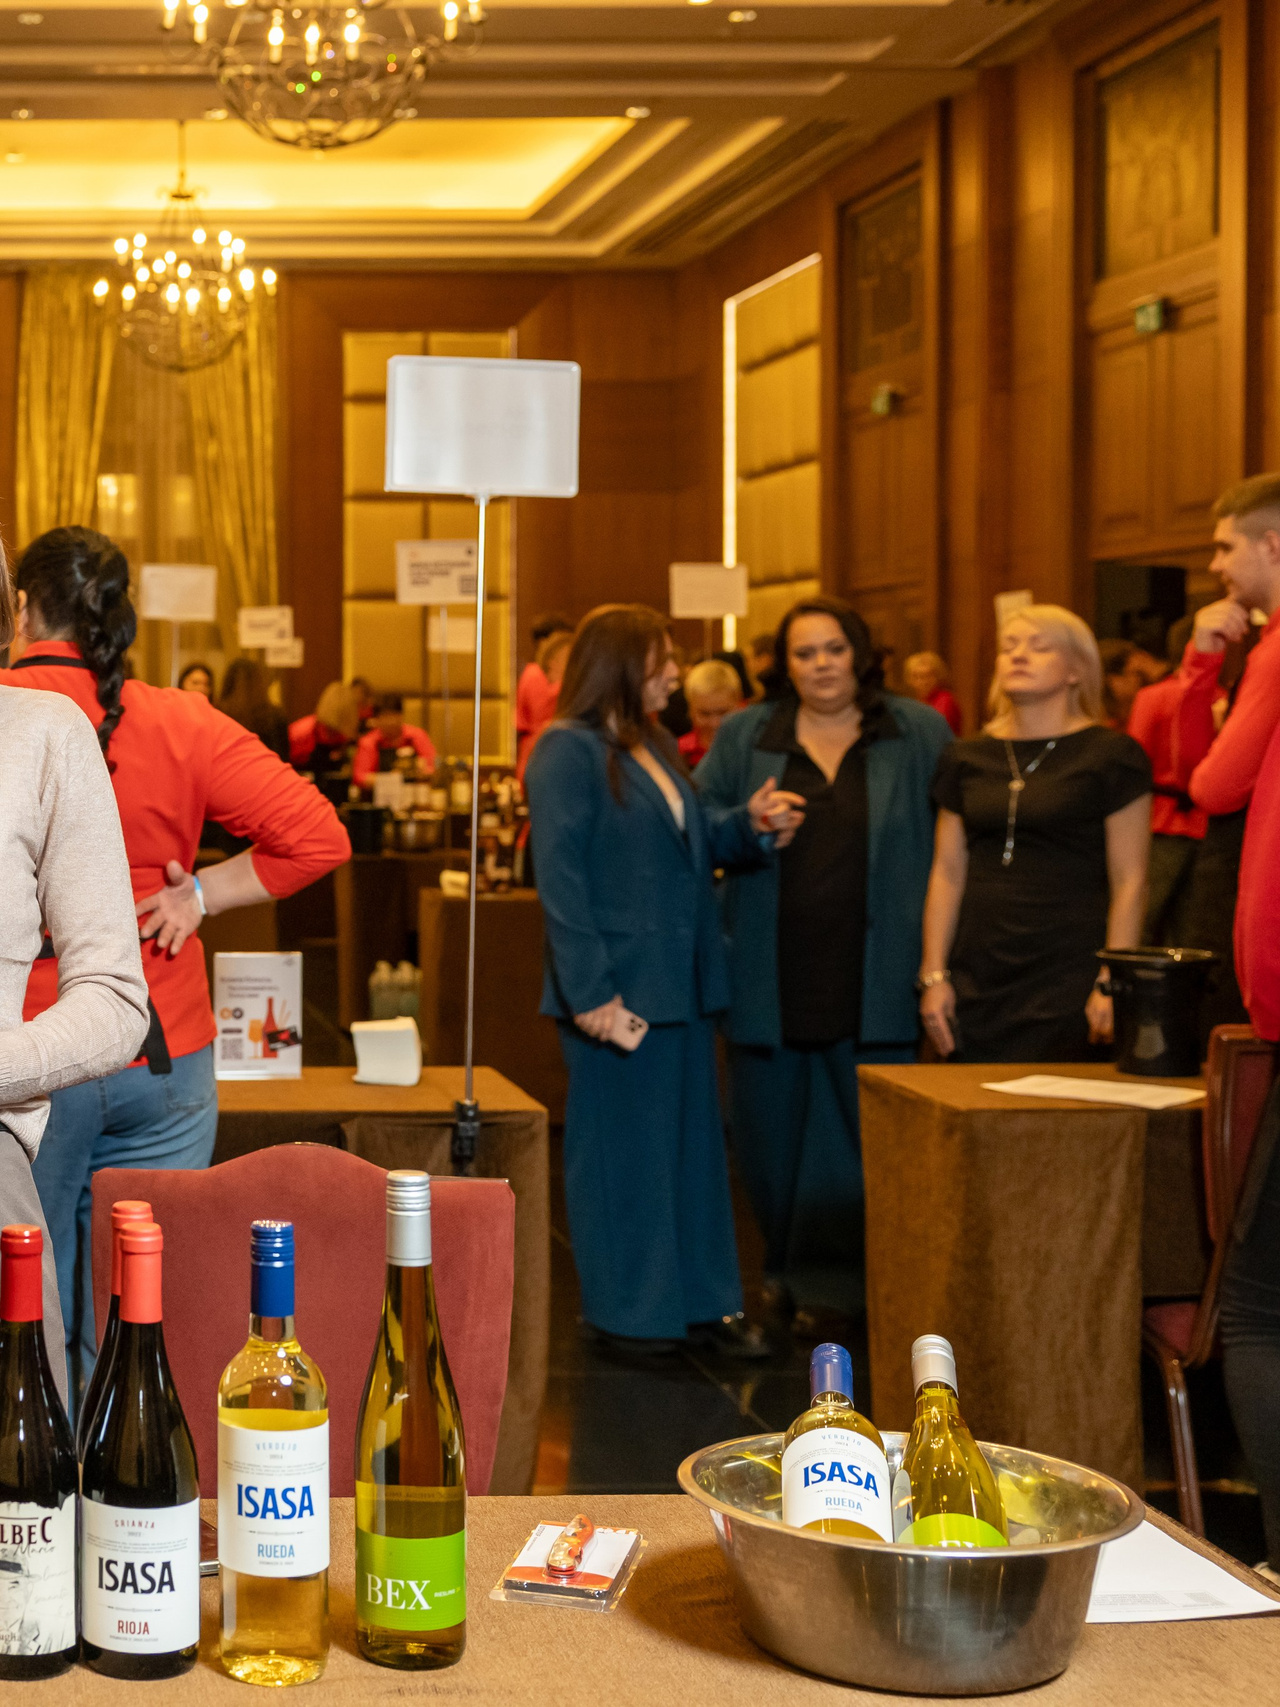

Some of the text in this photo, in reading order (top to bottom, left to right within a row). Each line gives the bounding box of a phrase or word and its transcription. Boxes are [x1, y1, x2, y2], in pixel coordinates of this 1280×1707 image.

[255, 1442, 298, 1452] VERDEJO
[821, 1433, 862, 1447] VERDEJO
[803, 1461, 880, 1499] ISASA
[236, 1483, 315, 1520] ISASA
[825, 1496, 863, 1512] RUEDA
[114, 1519, 156, 1529] CRIANZA
[257, 1543, 296, 1558] RUEDA
[98, 1556, 176, 1595] ISASA
[365, 1573, 433, 1611] BEX
[117, 1620, 150, 1635] RIOJA
